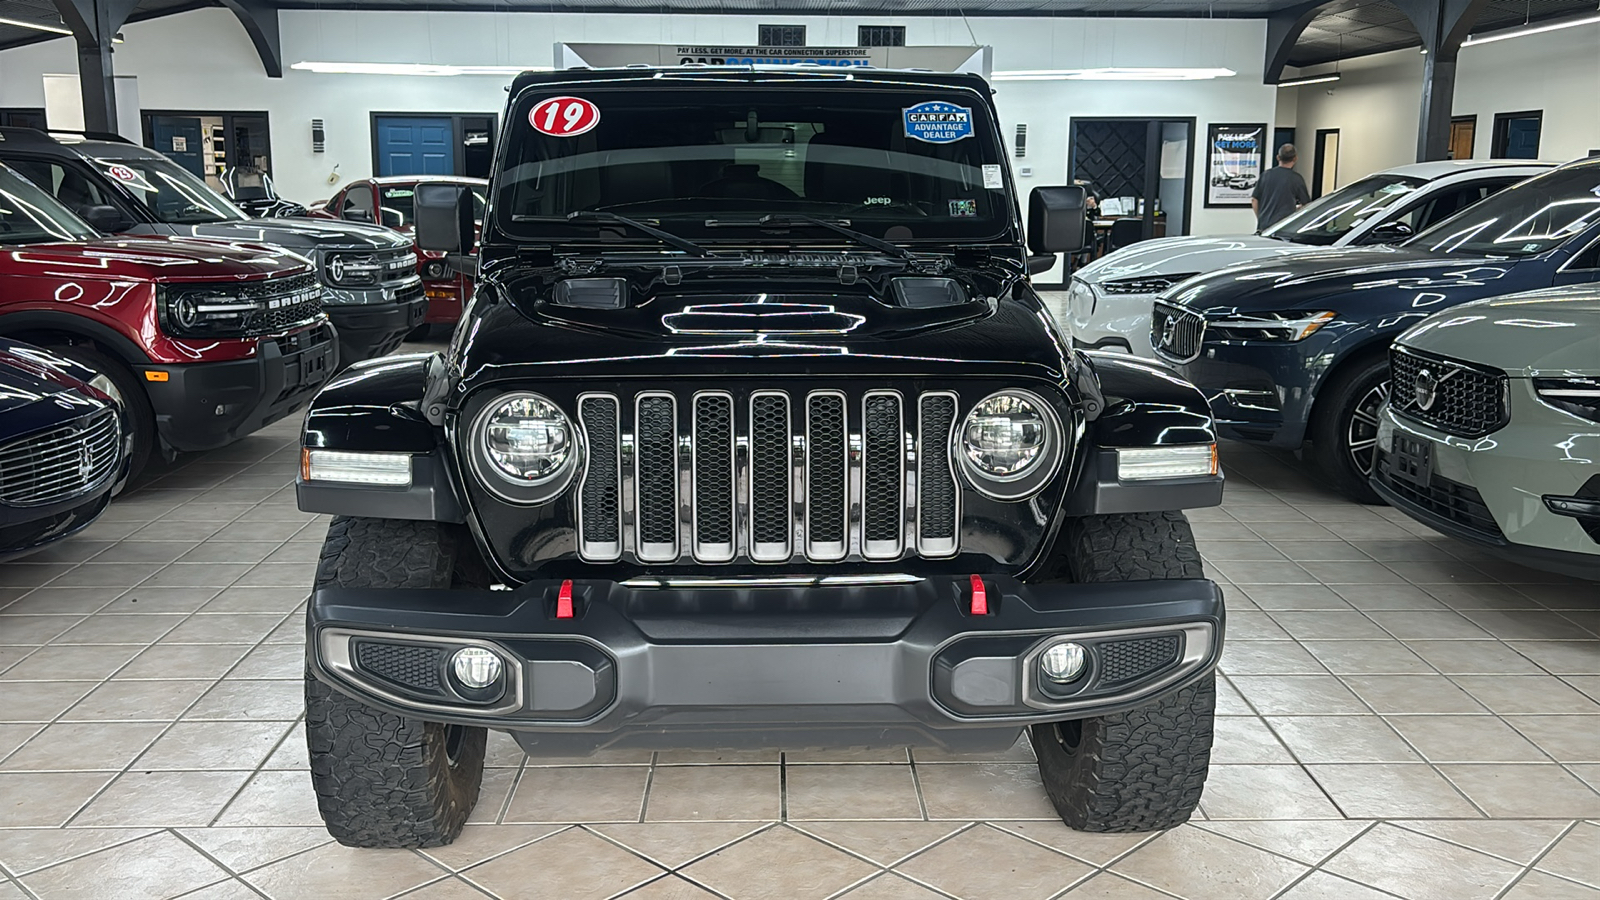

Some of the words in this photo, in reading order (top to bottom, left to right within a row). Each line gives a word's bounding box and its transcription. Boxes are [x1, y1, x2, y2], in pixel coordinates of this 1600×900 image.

[544, 102, 584, 131] 19
[914, 123, 964, 131] ADVANTAGE
[1214, 140, 1231, 149] GET
[863, 196, 892, 206] Jeep
[268, 289, 321, 309] BRONCO
